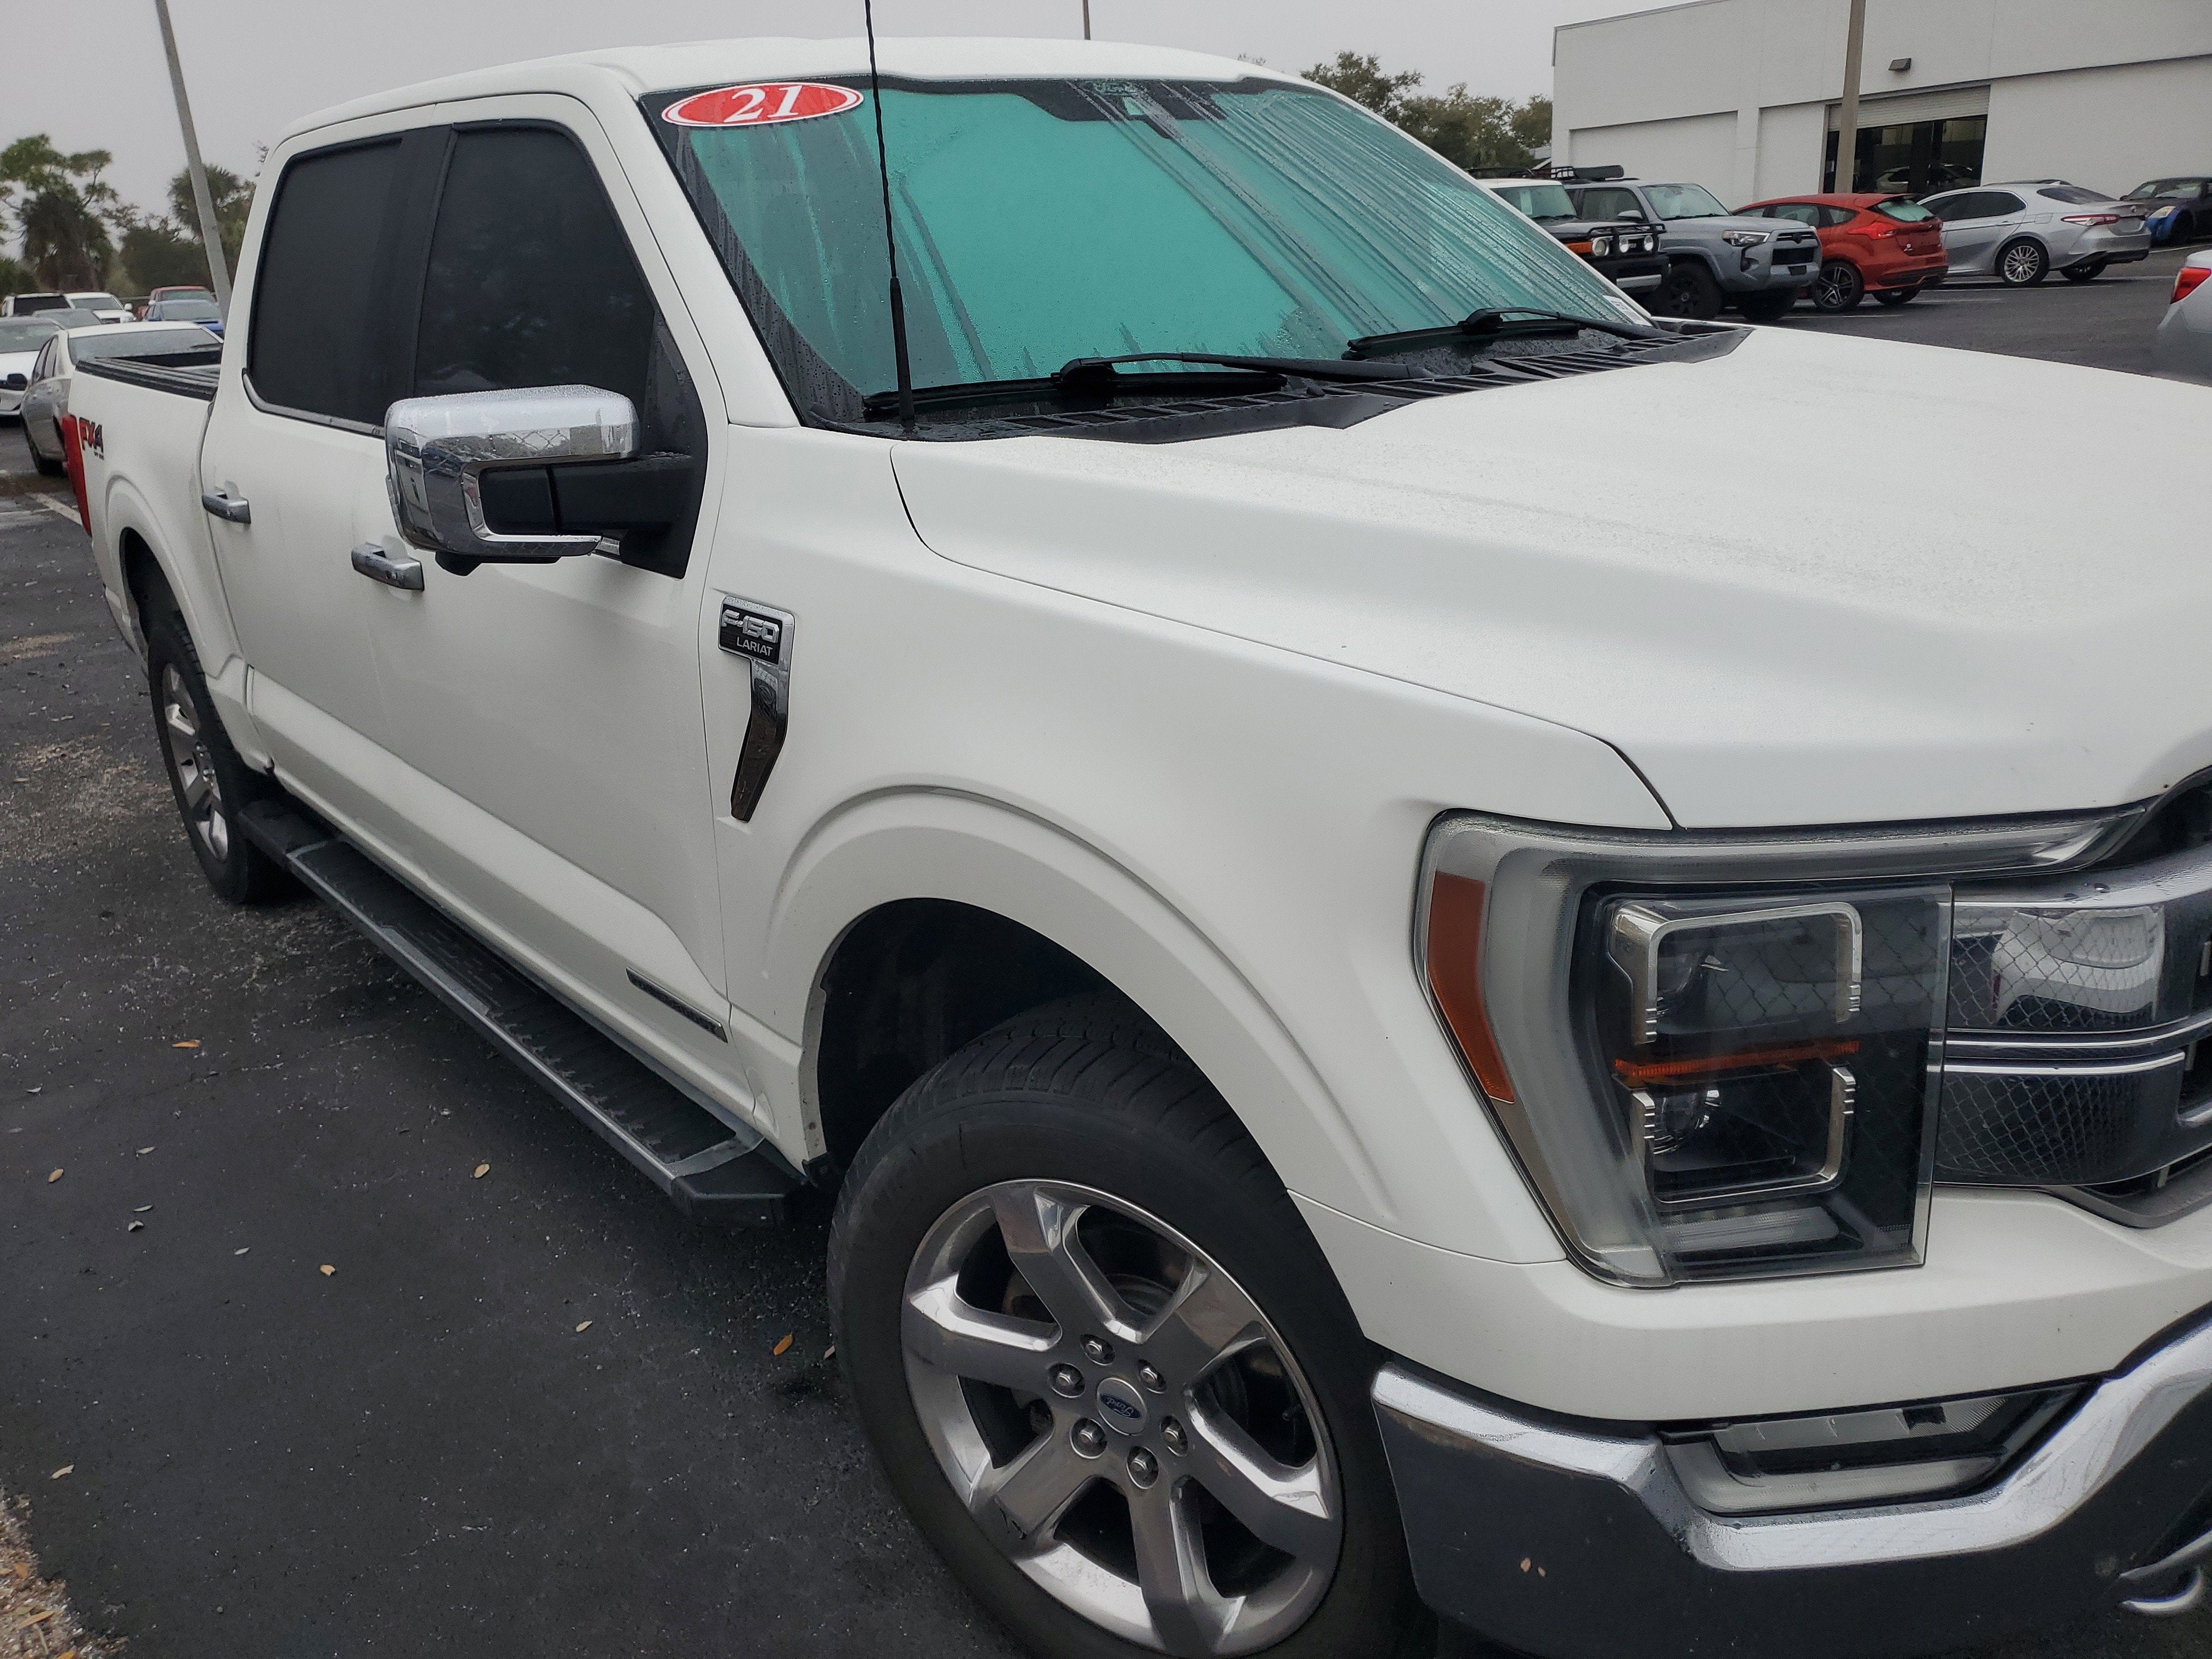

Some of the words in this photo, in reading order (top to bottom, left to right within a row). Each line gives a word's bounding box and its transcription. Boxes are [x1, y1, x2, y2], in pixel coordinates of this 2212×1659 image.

[723, 84, 803, 124] 21
[79, 417, 104, 453] FX4
[721, 609, 780, 643] F-150
[737, 636, 774, 657] LARIAT
